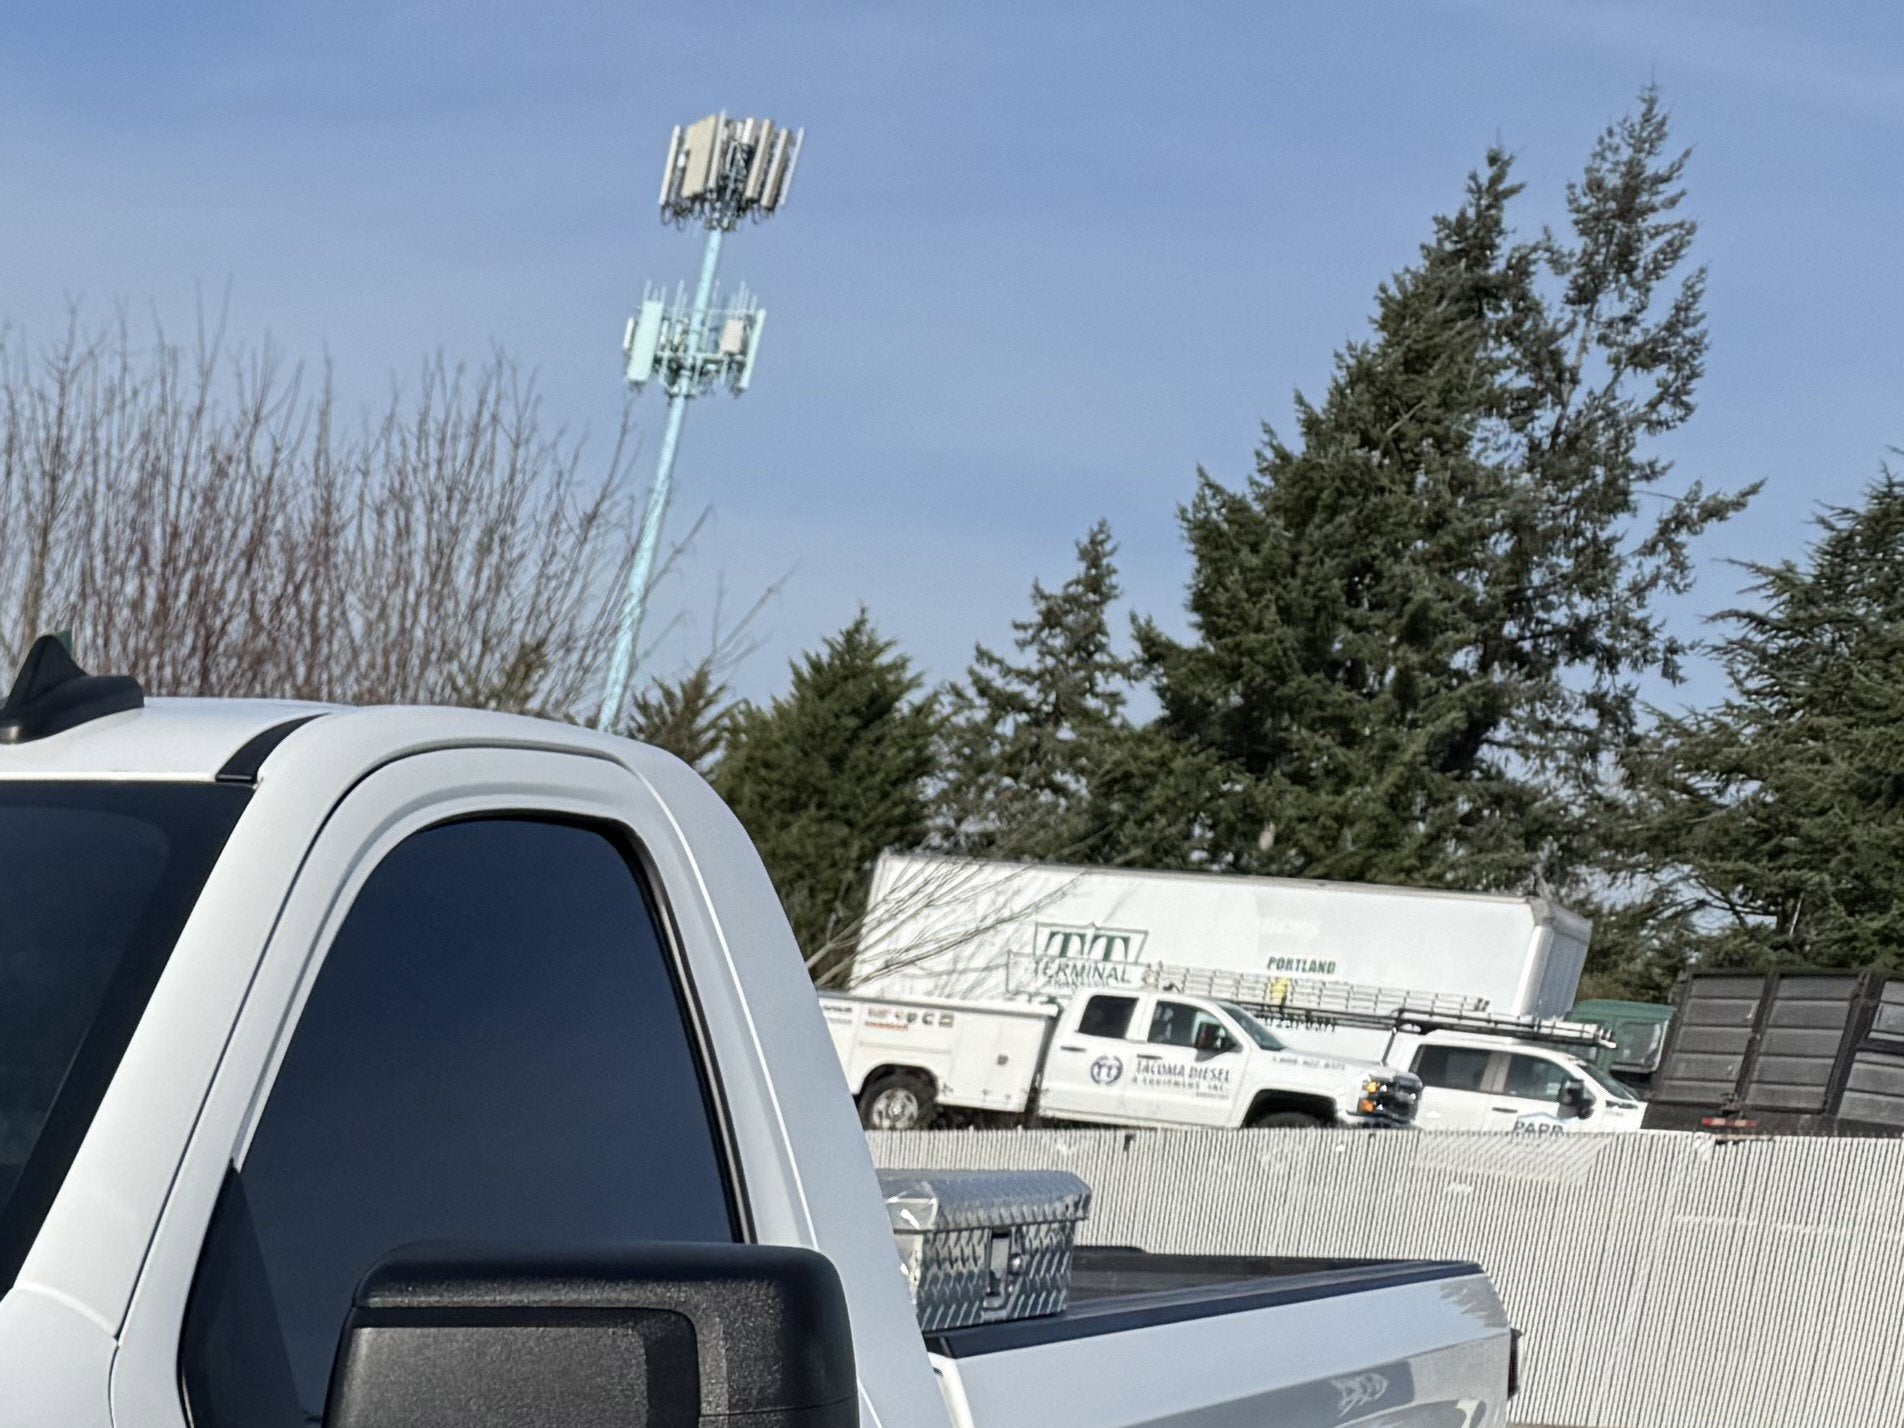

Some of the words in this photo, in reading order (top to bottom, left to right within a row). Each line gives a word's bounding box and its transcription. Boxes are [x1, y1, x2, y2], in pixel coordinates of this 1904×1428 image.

[1044, 930, 1130, 961] TT
[1034, 957, 1132, 985] TERMINAL
[1267, 956, 1337, 975] PORTLAND
[1136, 1058, 1185, 1077] TACOMA
[1188, 1065, 1230, 1083] DIESEL
